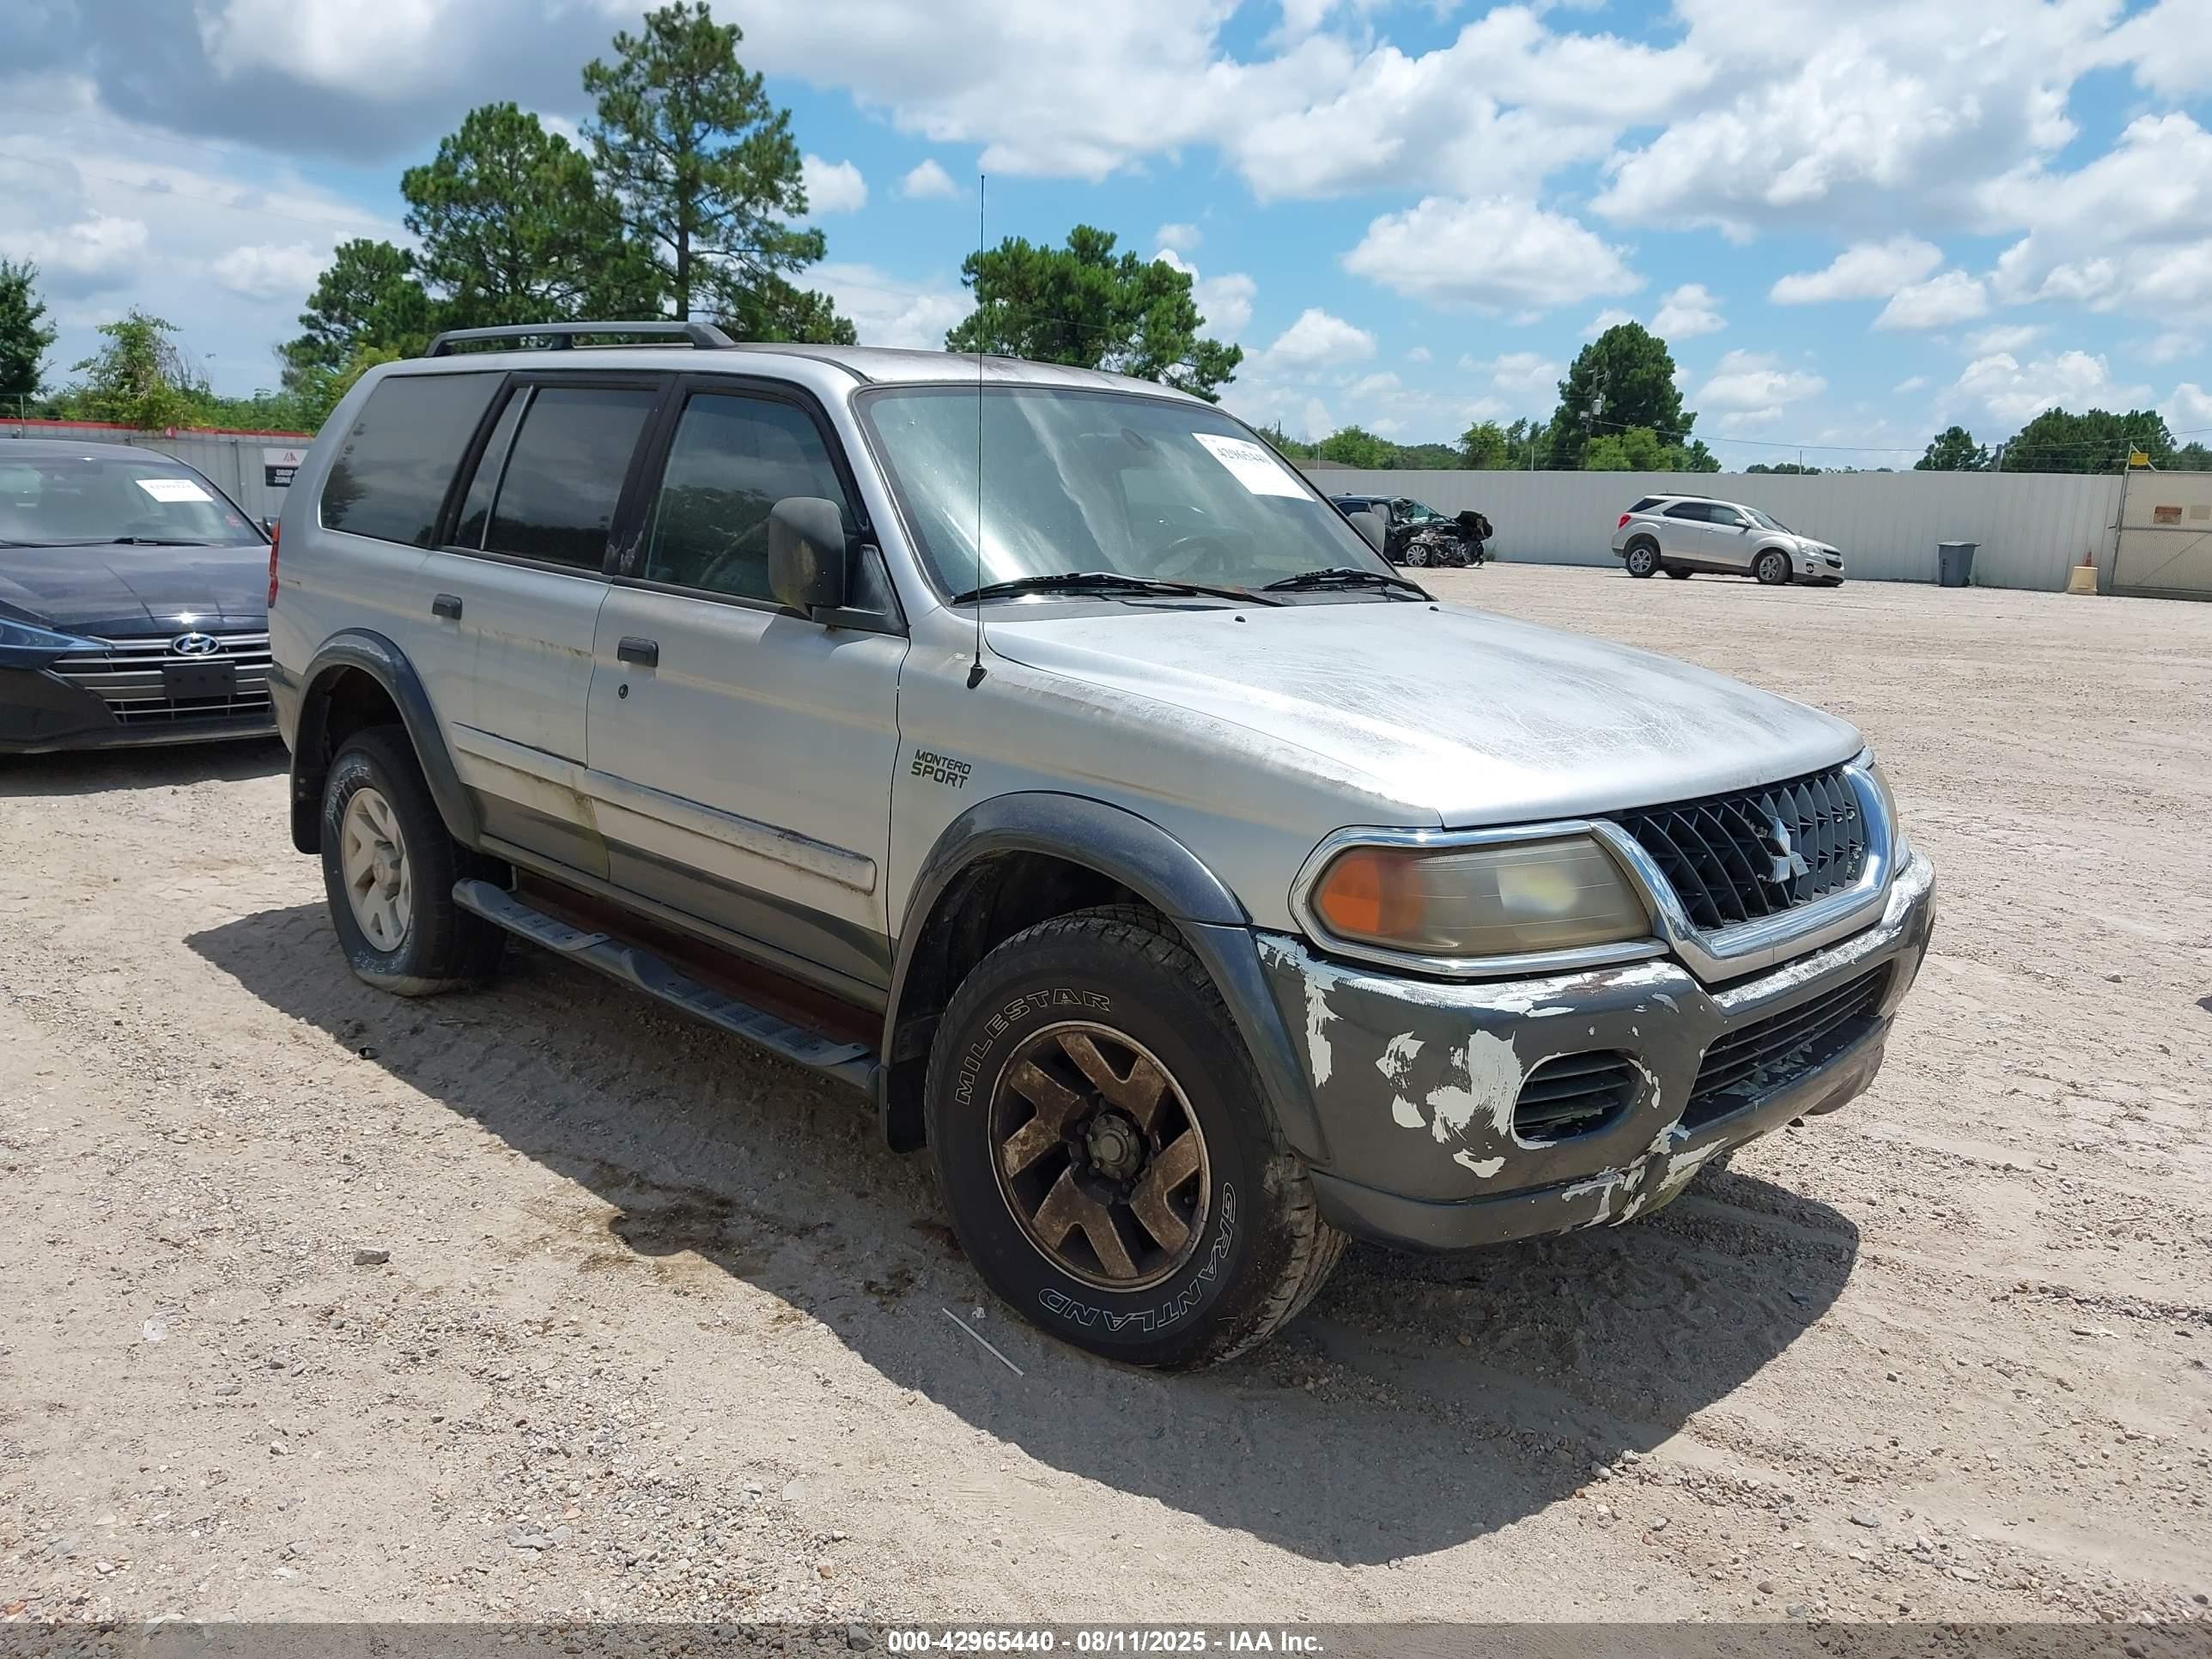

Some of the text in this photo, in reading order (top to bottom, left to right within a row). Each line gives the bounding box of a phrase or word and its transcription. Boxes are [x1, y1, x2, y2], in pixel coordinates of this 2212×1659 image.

[910, 761, 968, 789] SPORT
[915, 749, 971, 775] MONTERO
[955, 988, 1112, 1105] MILESTAR
[1038, 1182, 1237, 1332] GRANTLAND
